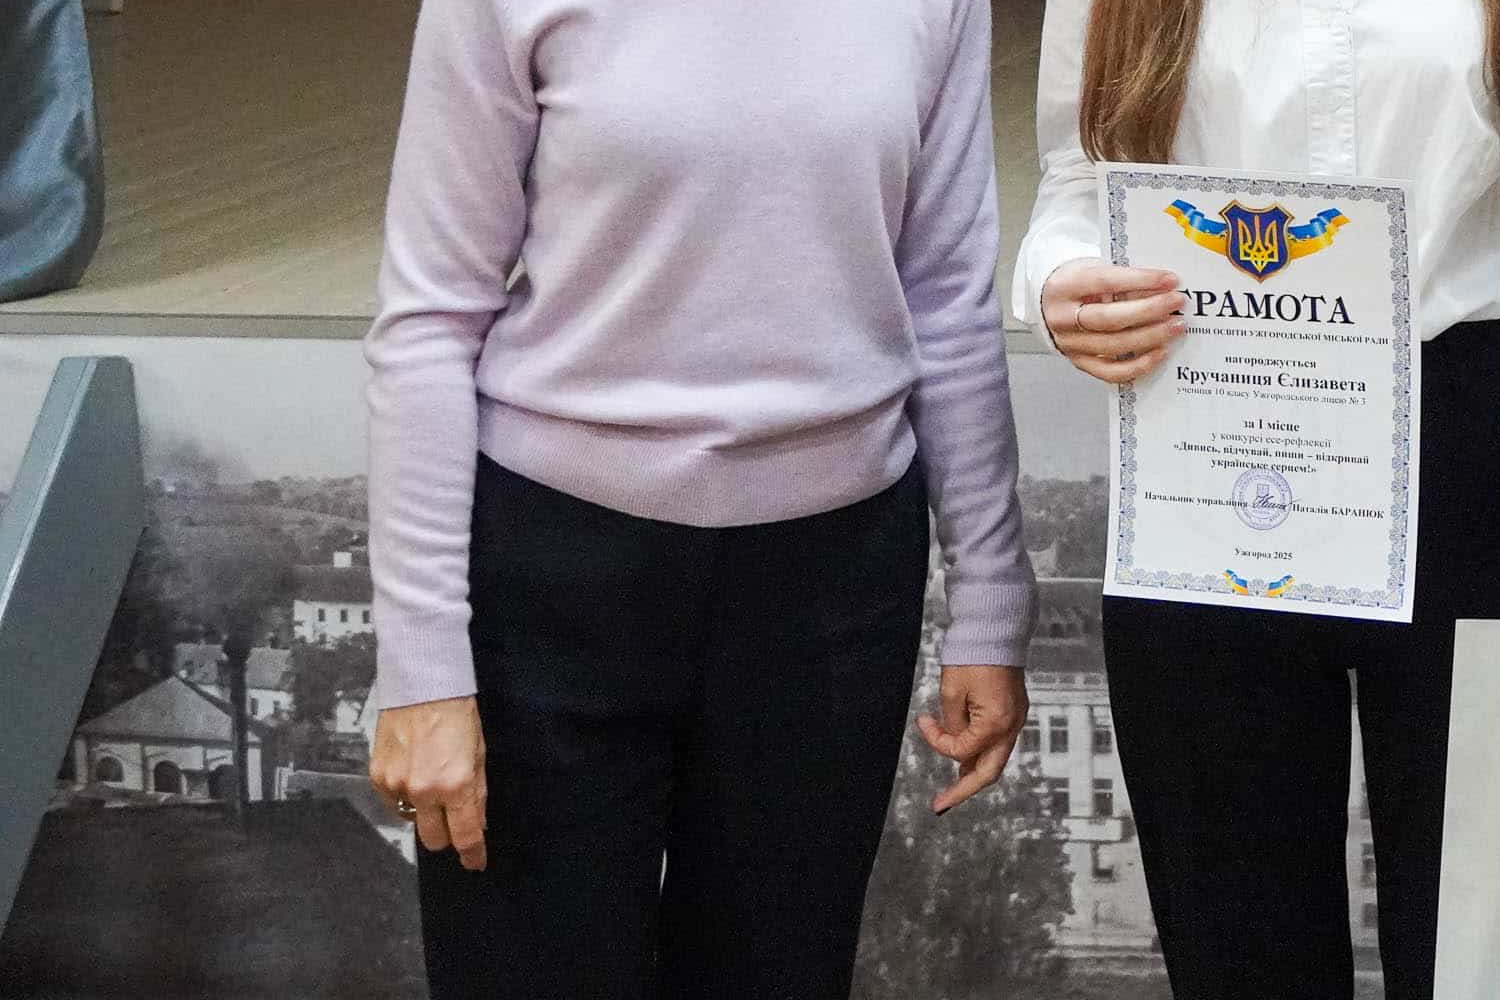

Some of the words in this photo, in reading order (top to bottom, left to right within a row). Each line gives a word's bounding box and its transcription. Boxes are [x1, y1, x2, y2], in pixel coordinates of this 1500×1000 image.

[1213, 327, 1247, 337] ОСВІТИ
[1249, 328, 1322, 341] УЖГОРОДСЬКОЇ
[1324, 333, 1363, 344] МІСЬКОЇ
[1364, 337, 1389, 346] РАДИ
[1225, 355, 1317, 369] нагороджується
[1176, 366, 1272, 386] Кручаниця
[1277, 373, 1366, 392] Єлизавета
[1176, 386, 1212, 396] учениця
[1214, 387, 1225, 396] 10
[1226, 390, 1249, 400] класу
[1252, 390, 1319, 403] Ужгородського
[1243, 420, 1255, 429] за
[1267, 420, 1300, 432] місце
[1220, 433, 1262, 445] конкурсі
[1265, 436, 1332, 449] есе-рефлексії
[1211, 457, 1269, 471] українське
[1274, 450, 1304, 460] пиши
[1315, 453, 1370, 465] відкривай
[1144, 491, 1194, 504] Начальник
[1196, 496, 1248, 509] управління
[1292, 503, 1329, 515] Наталія
[1330, 506, 1385, 519] БАРАНЮК
[1234, 547, 1271, 560] Ужгород
[1272, 550, 1293, 560] 2025
